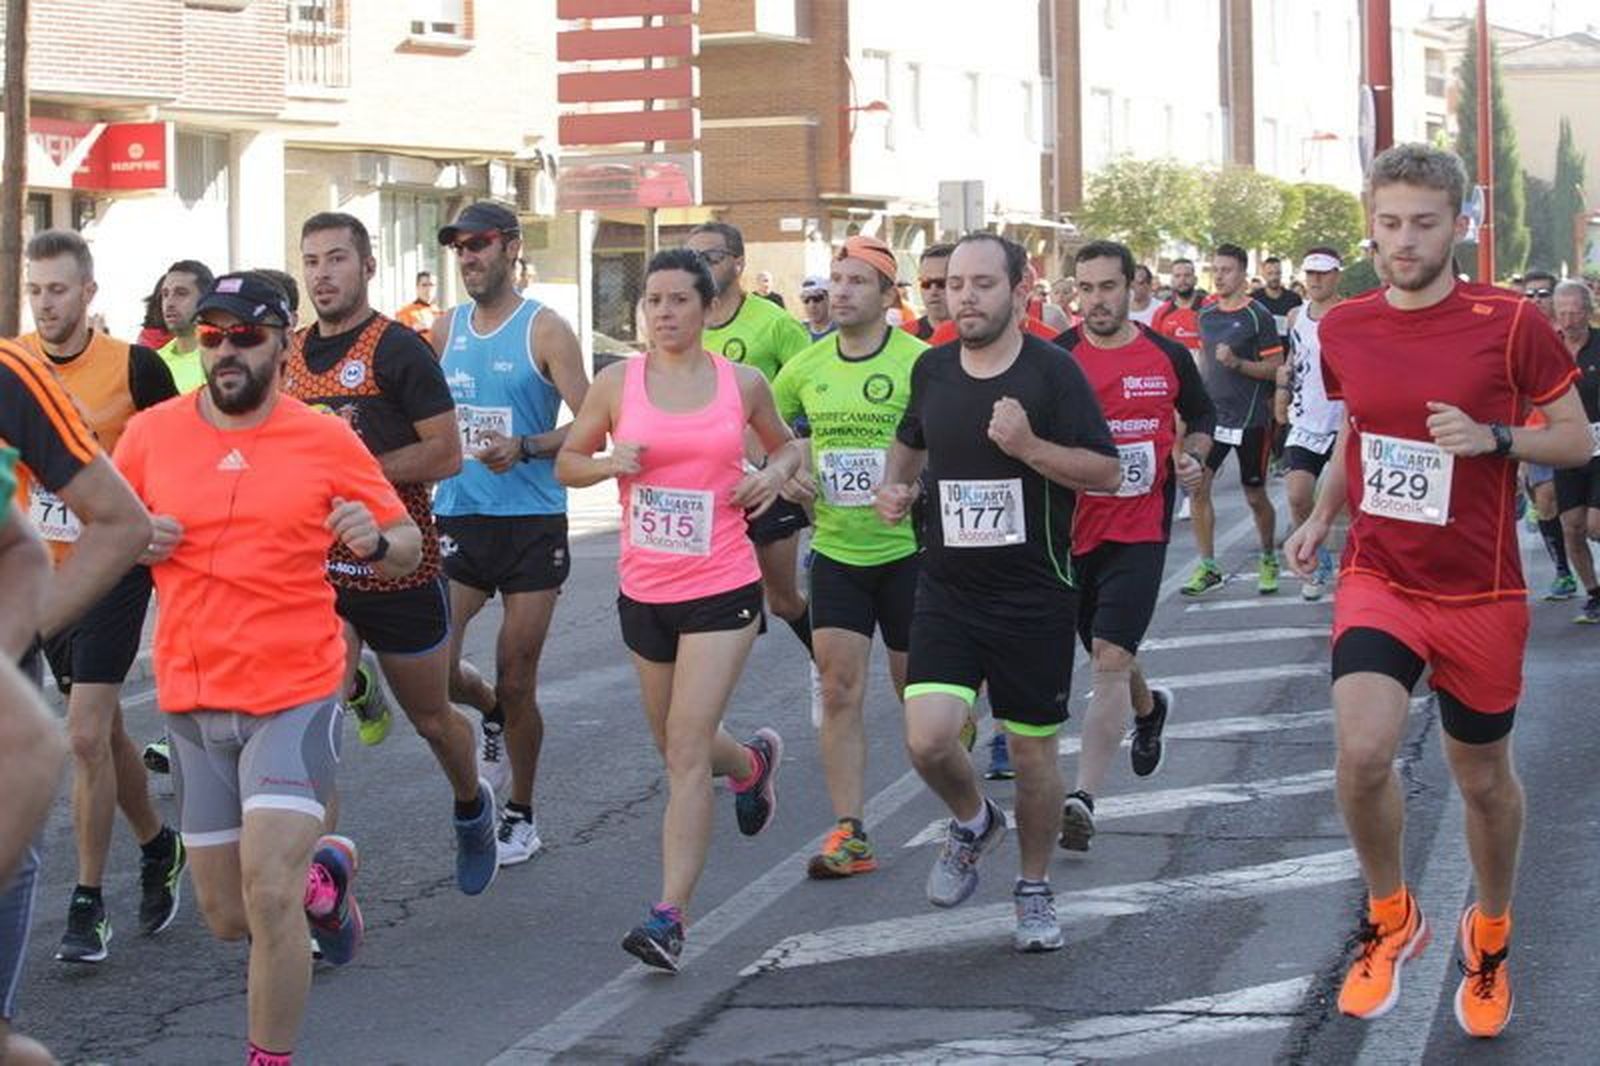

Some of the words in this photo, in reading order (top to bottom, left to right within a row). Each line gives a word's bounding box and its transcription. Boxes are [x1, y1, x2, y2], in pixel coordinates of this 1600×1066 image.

[1106, 418, 1160, 432] REIRA
[829, 471, 871, 491] 126
[1367, 467, 1428, 501] 429
[40, 502, 67, 525] 71
[641, 511, 694, 538] 515
[954, 507, 1005, 529] 177
